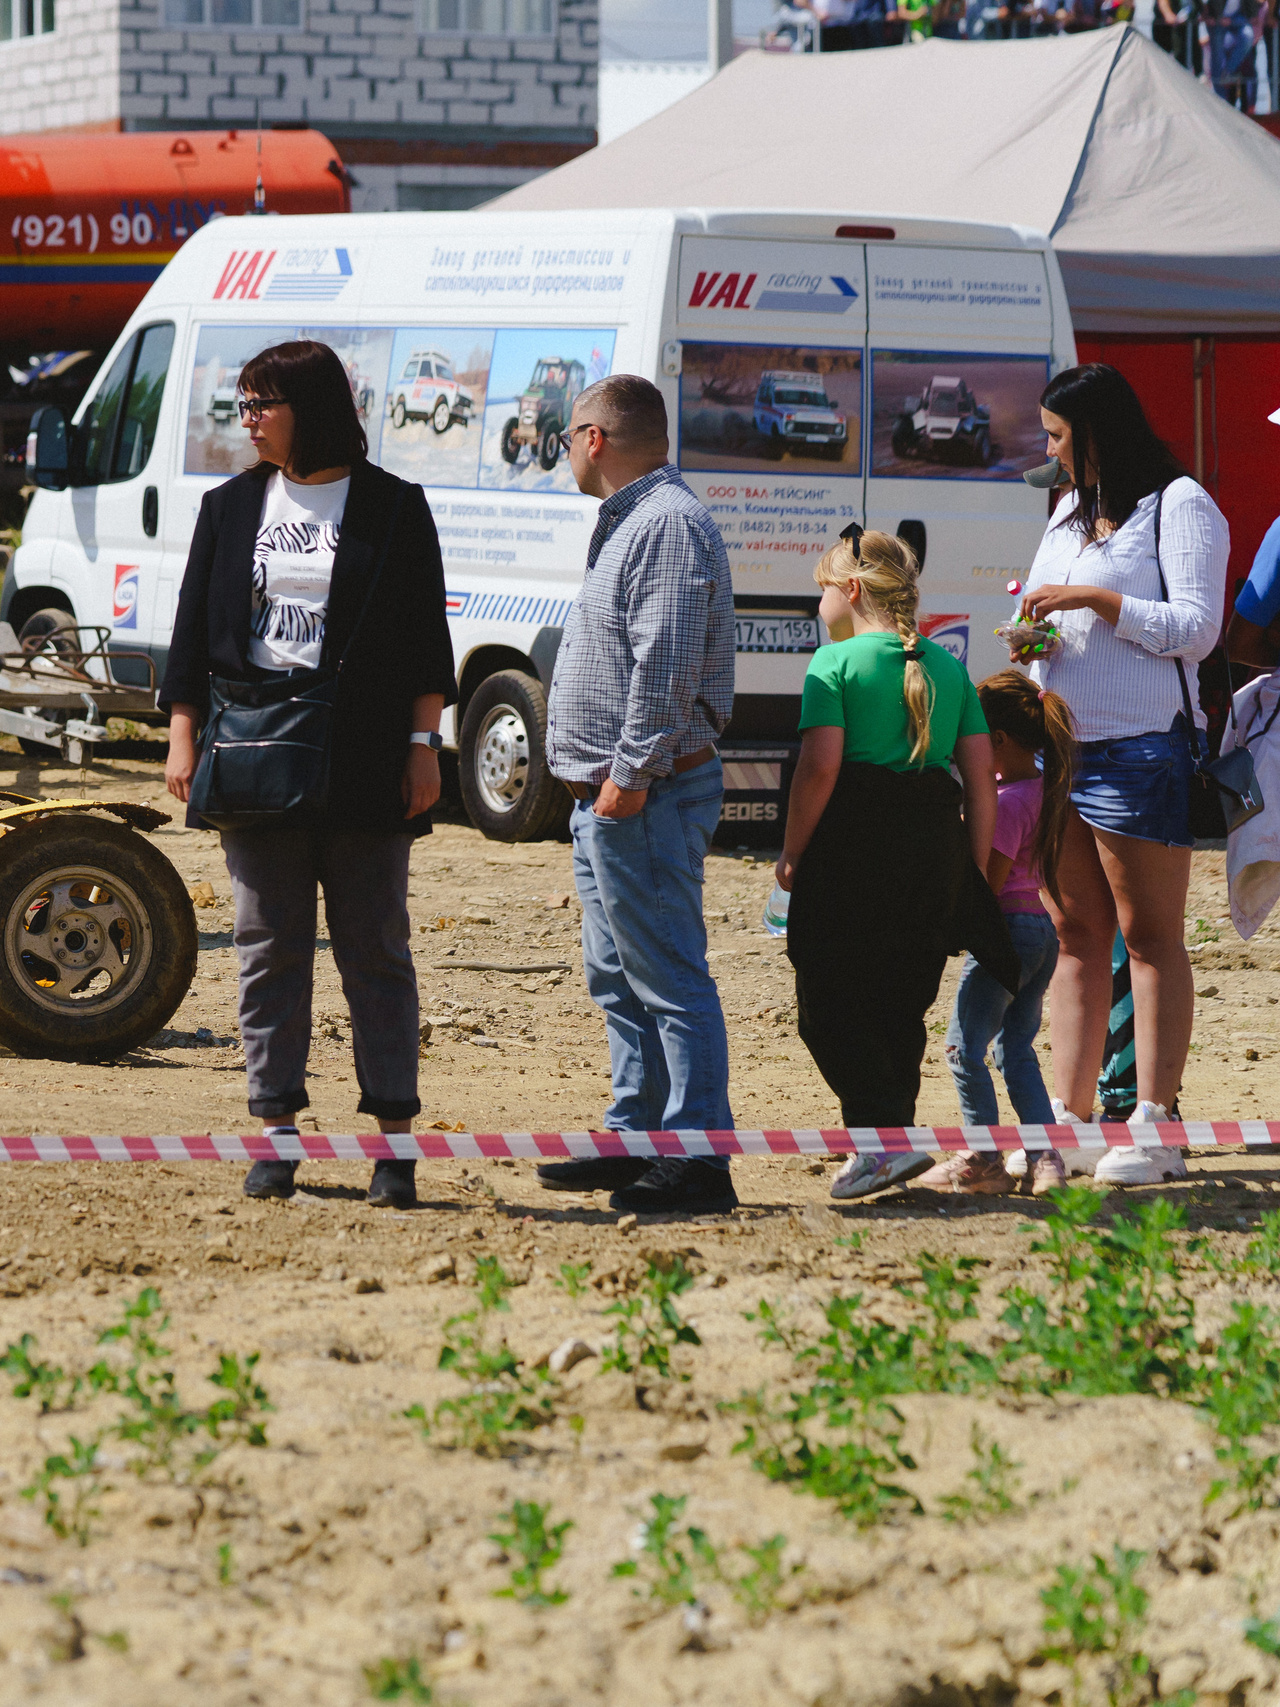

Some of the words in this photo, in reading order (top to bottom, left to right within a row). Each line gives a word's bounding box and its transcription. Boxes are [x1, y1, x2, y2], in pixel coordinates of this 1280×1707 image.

[213, 250, 277, 299] VAL
[281, 249, 329, 274] racing
[688, 272, 758, 308] VAL
[767, 271, 822, 294] racing
[707, 486, 737, 498] ООО
[706, 503, 742, 514] ятти,
[717, 523, 735, 532] ел:
[724, 539, 825, 555] ww.val-racing.ru
[784, 622, 812, 638] 159
